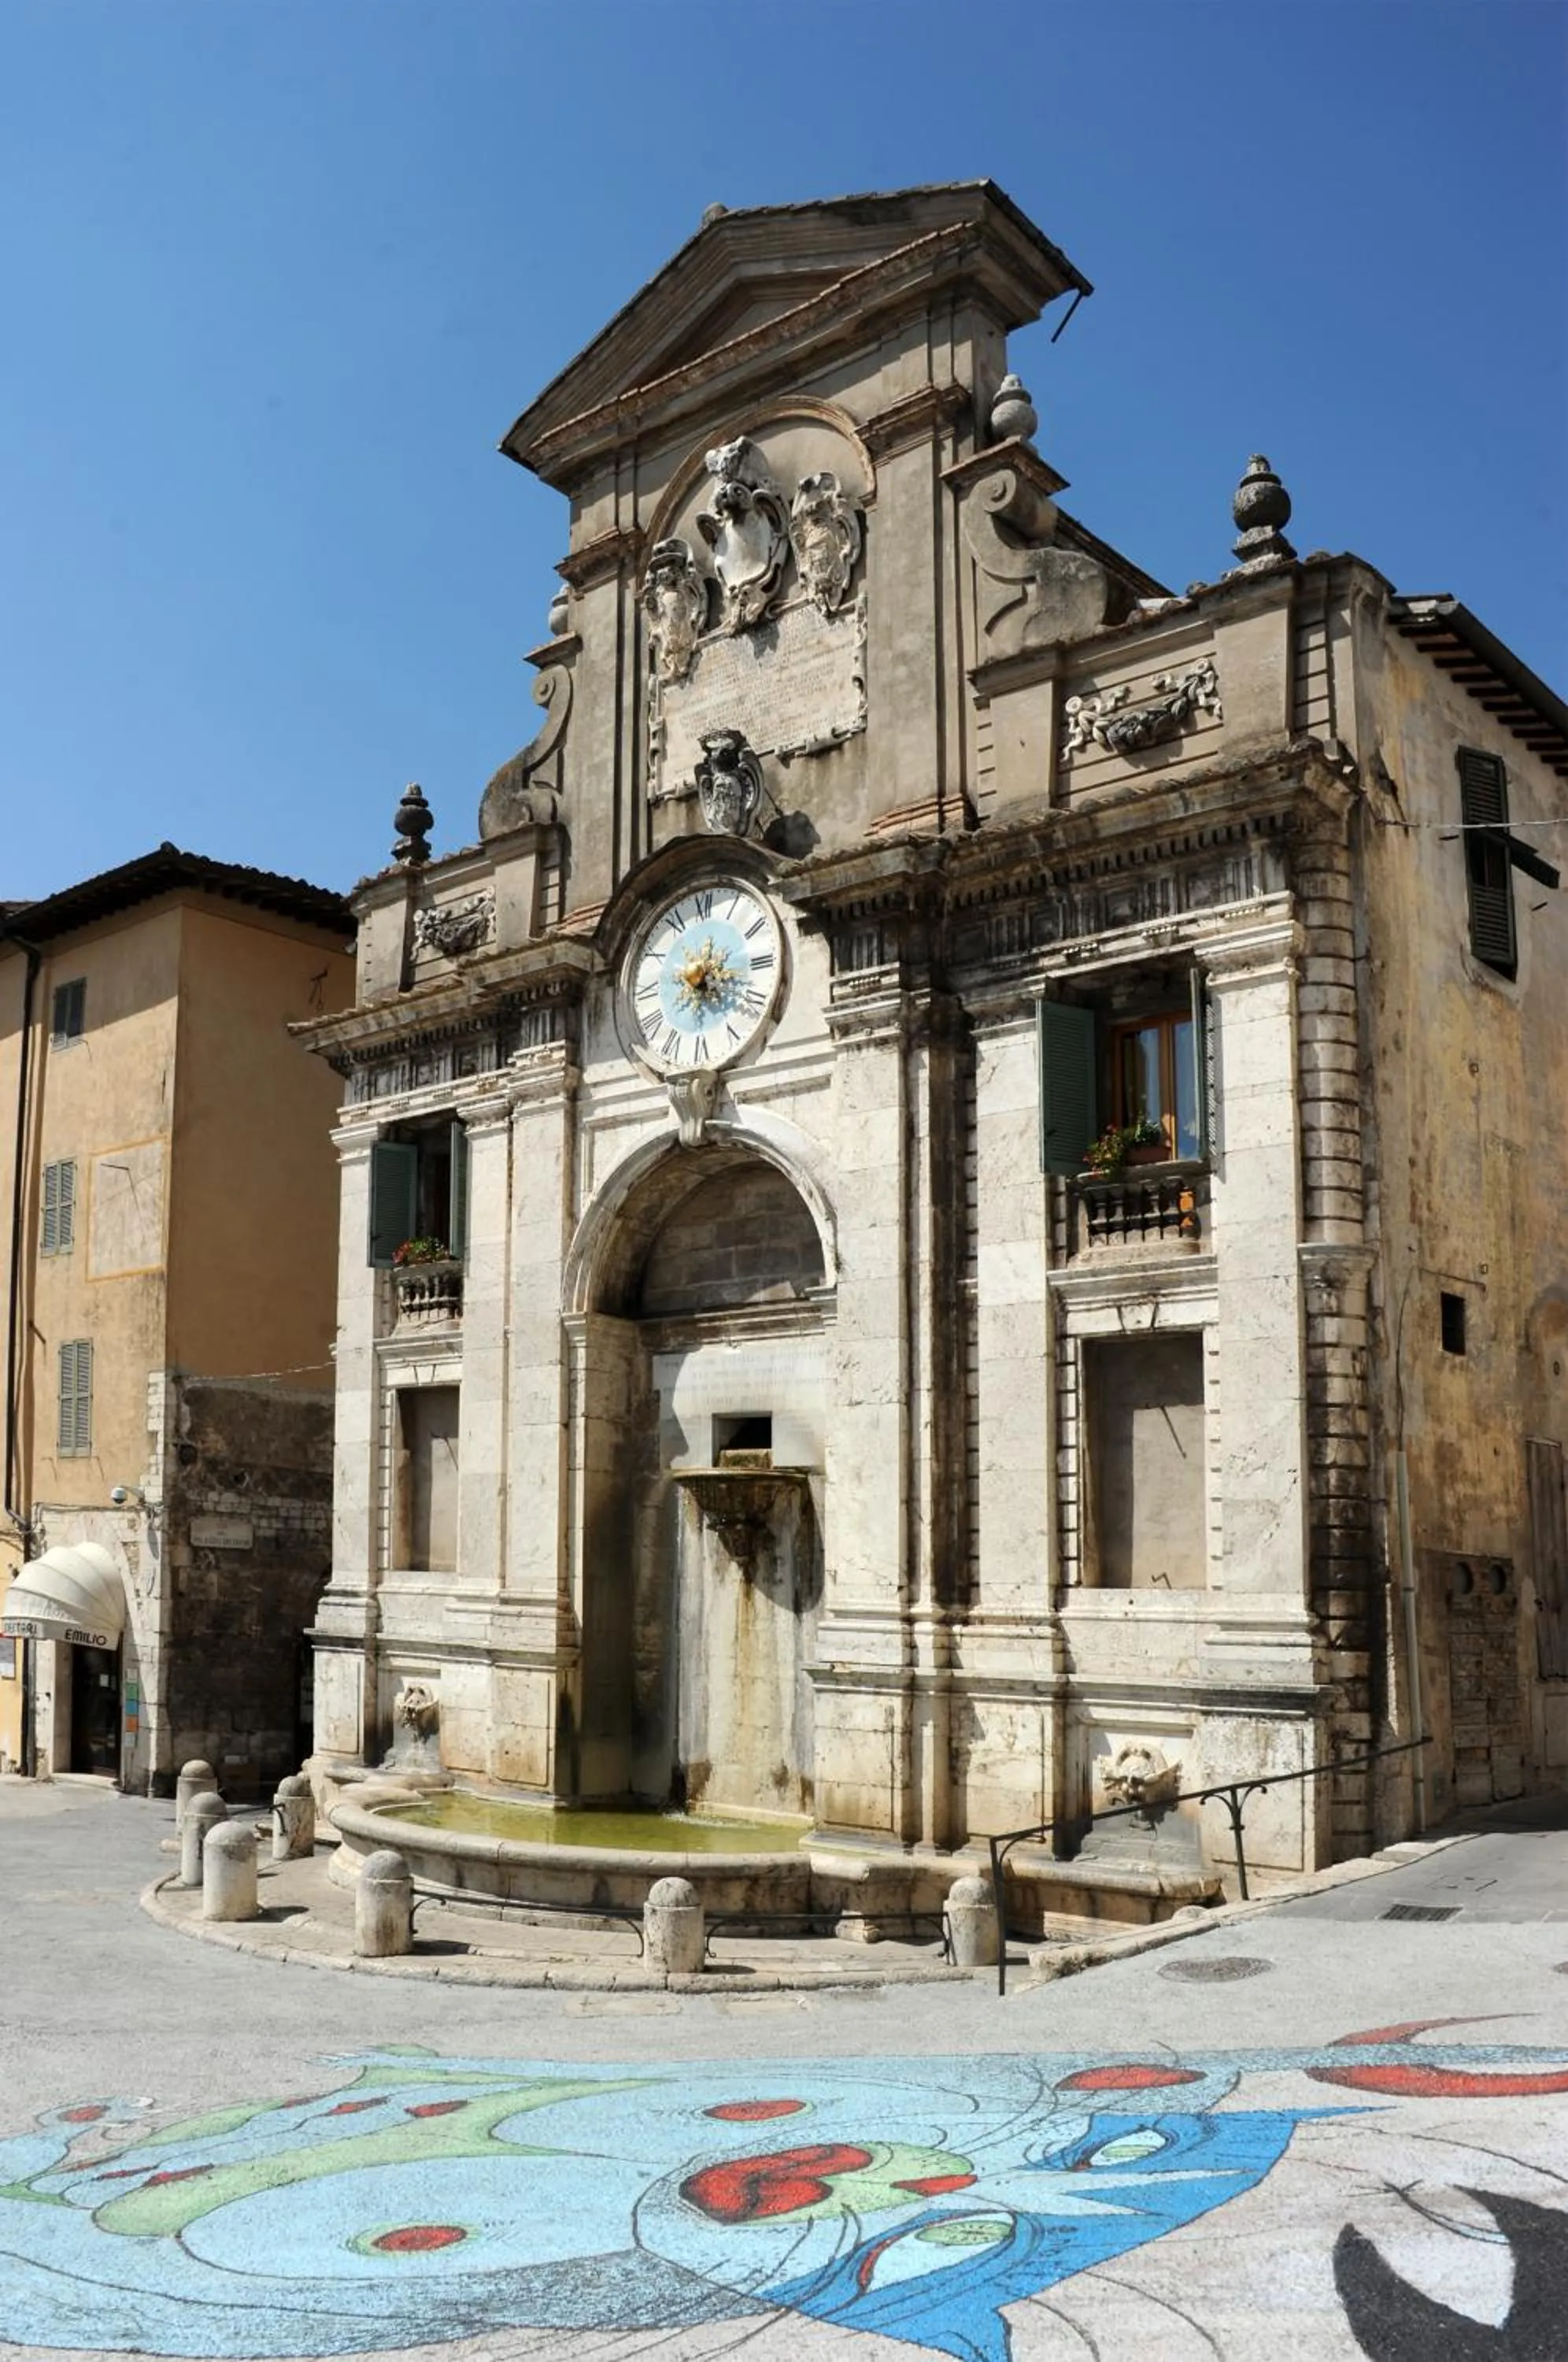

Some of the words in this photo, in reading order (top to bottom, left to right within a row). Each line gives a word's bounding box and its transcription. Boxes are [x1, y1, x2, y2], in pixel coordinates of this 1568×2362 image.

[745, 916, 766, 940] II
[750, 954, 774, 971] III
[65, 1628, 108, 1646] EMILIO
